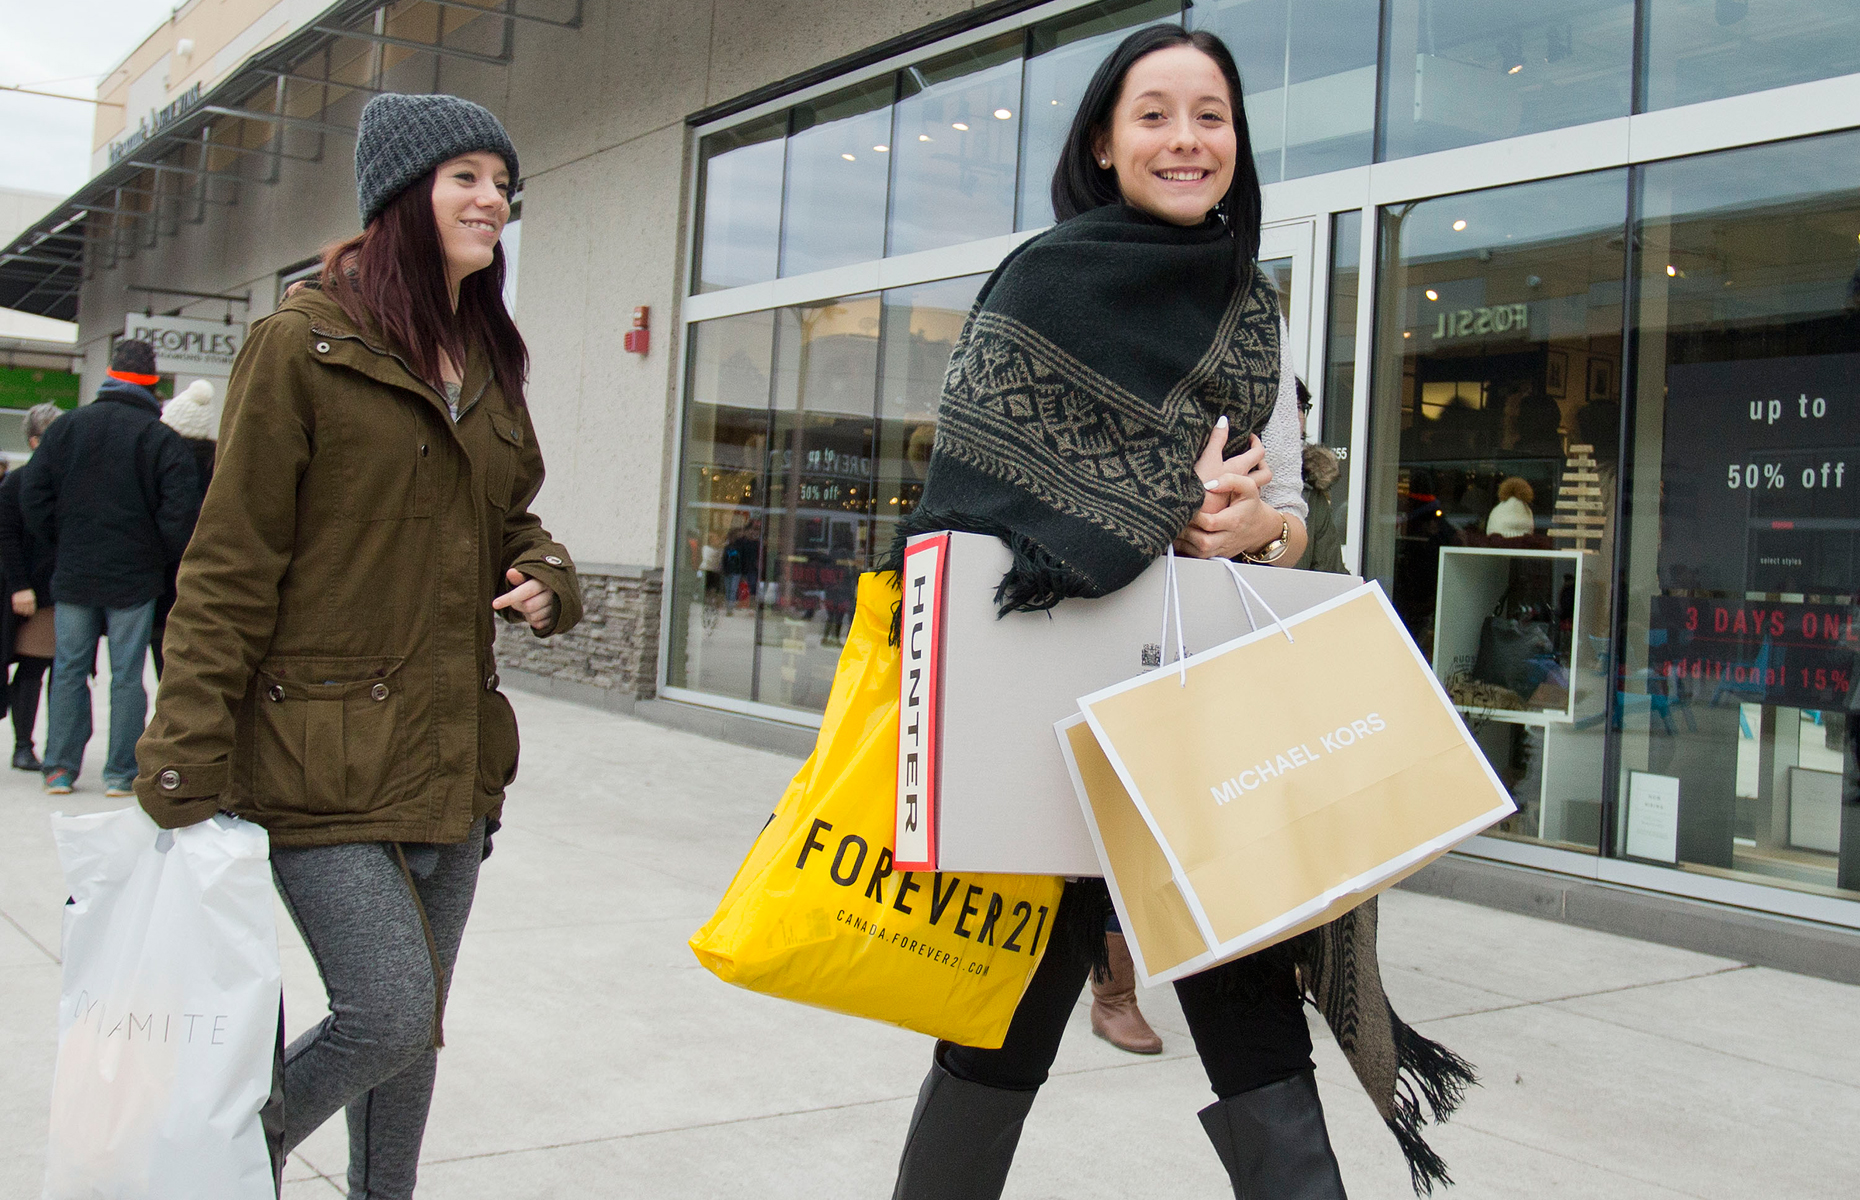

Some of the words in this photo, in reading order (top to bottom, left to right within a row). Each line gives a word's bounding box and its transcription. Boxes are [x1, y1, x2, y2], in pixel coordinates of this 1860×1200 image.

[134, 327, 237, 356] PEOPLES
[1749, 399, 1782, 425] up
[1798, 393, 1826, 418] to
[1727, 462, 1785, 490] 50%
[1801, 461, 1845, 489] off
[801, 485, 820, 501] 50%
[823, 485, 839, 501] off
[1685, 606, 1699, 631] 3
[1714, 607, 1785, 637] DAYS
[1802, 611, 1860, 642] ONL
[1662, 657, 1787, 687] additional
[1801, 666, 1851, 693] 15%
[905, 575, 926, 834] HUNTER
[1209, 743, 1321, 807] MICHAEL
[1319, 711, 1388, 755] KORS
